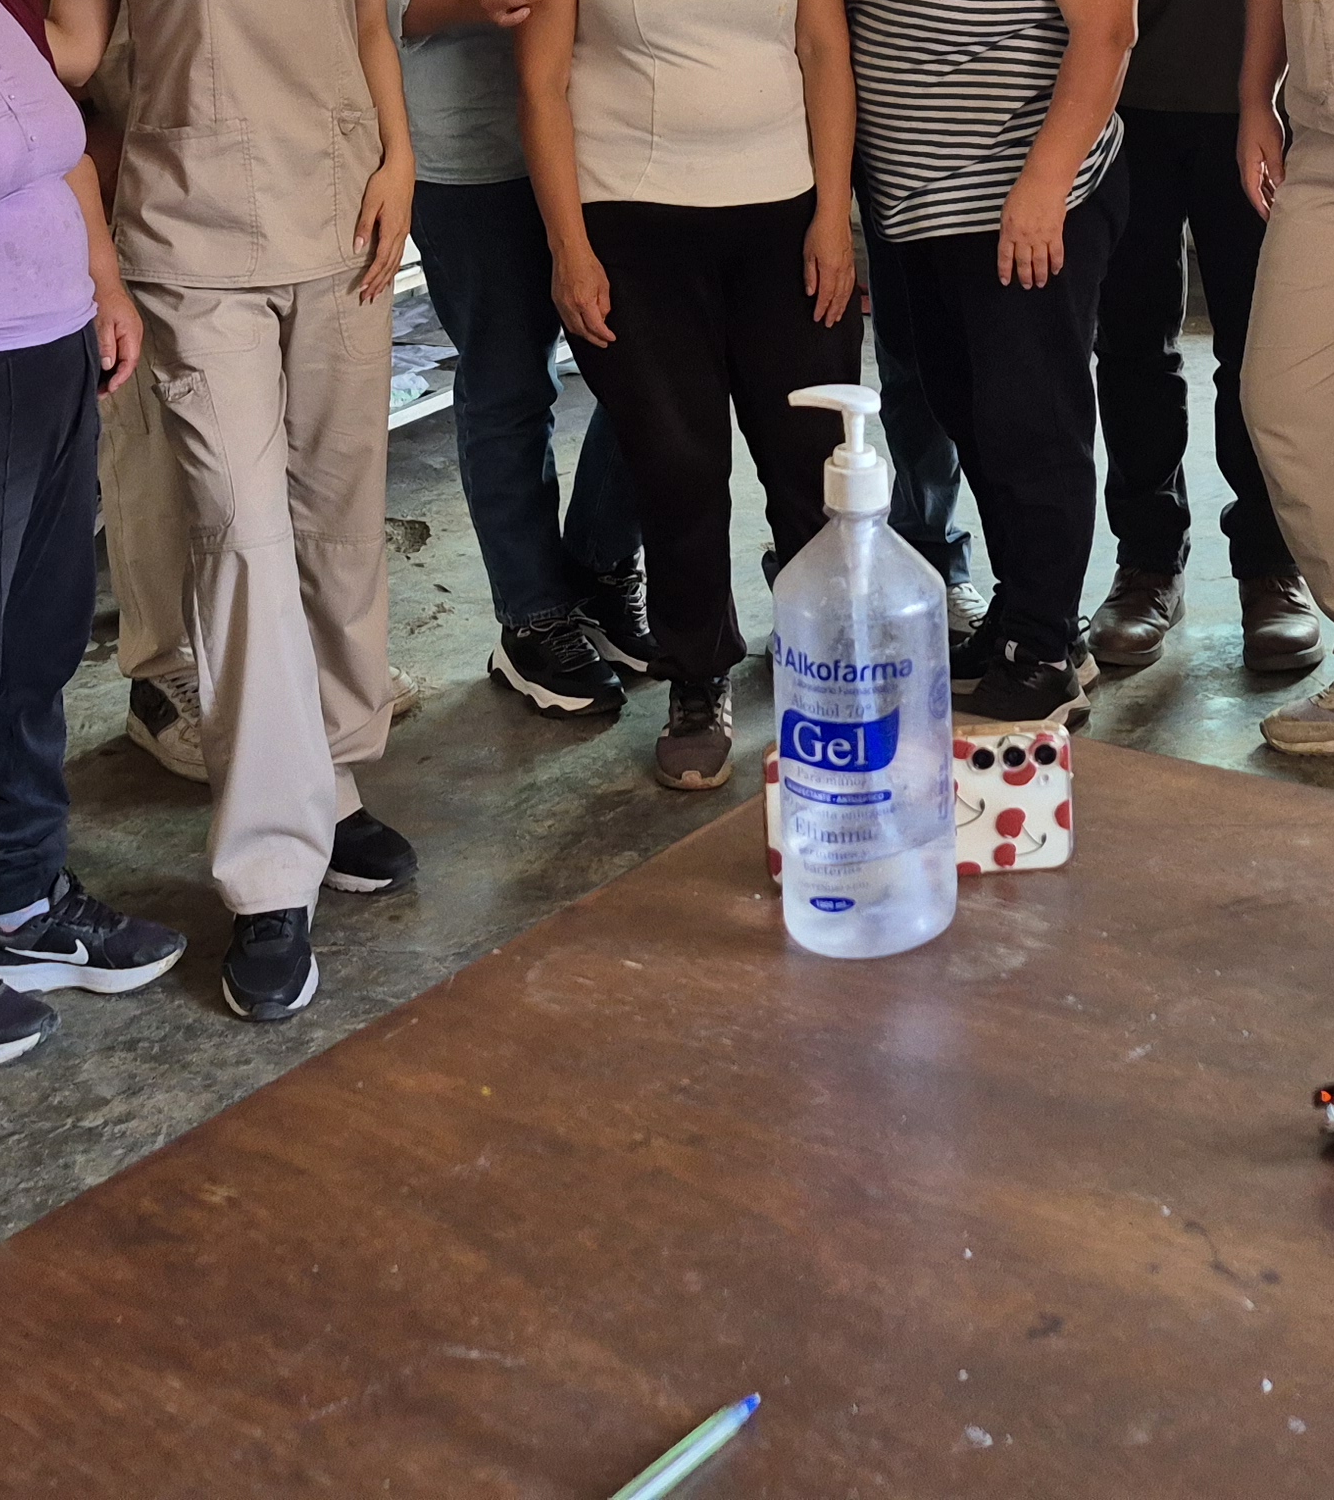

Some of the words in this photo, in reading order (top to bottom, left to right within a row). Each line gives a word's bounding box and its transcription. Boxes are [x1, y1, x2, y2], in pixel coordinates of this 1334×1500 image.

[785, 646, 914, 683] Alkofarma
[791, 692, 840, 718] Alcohol
[792, 720, 868, 767] Gel
[795, 815, 875, 844] Elimina
